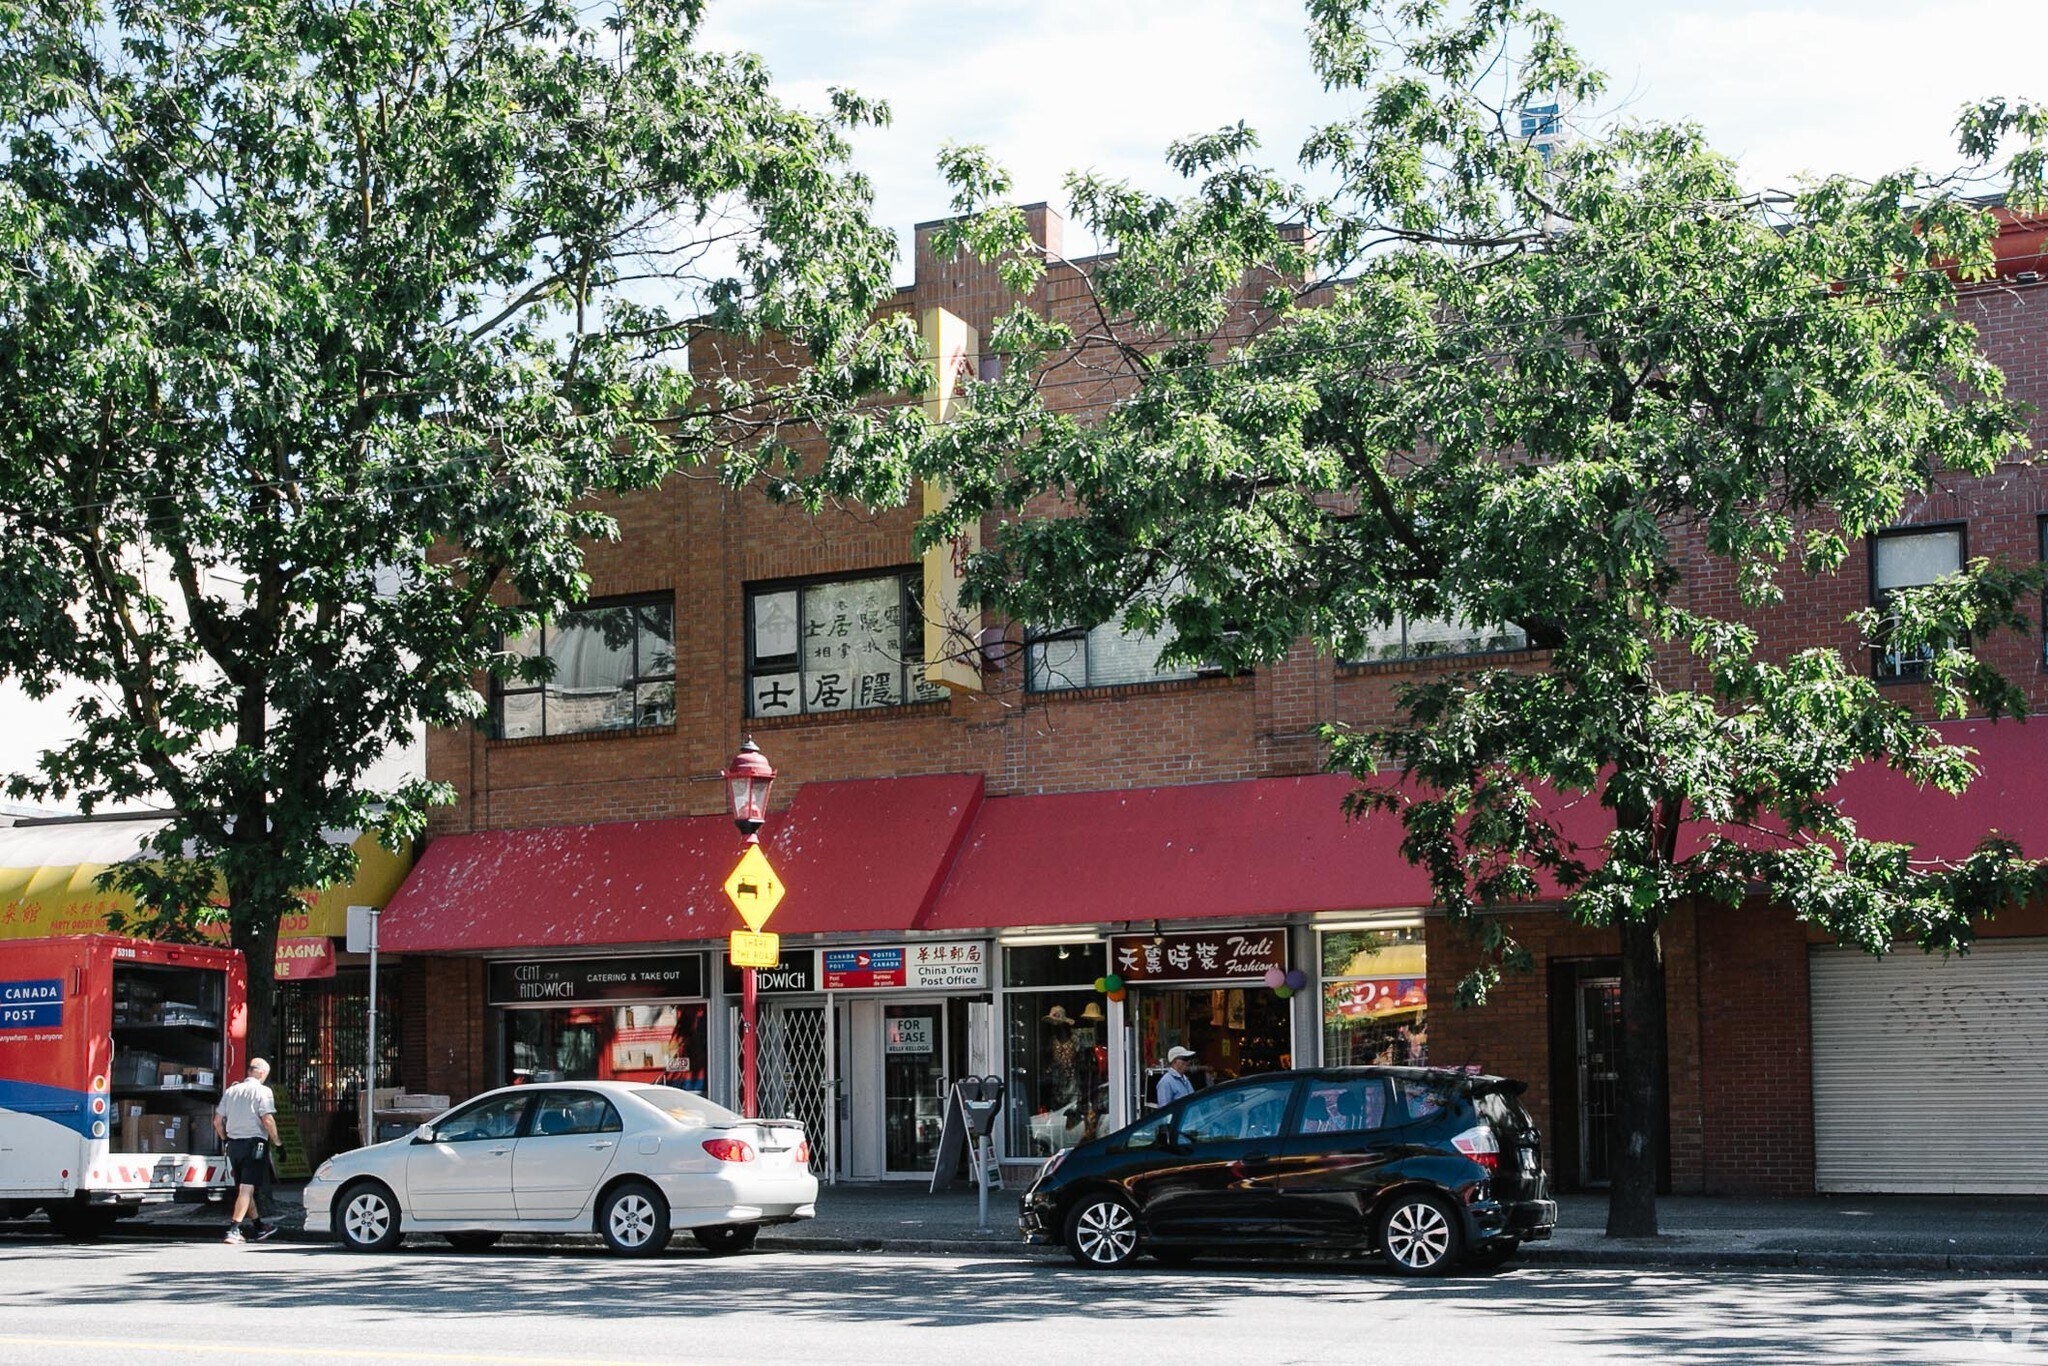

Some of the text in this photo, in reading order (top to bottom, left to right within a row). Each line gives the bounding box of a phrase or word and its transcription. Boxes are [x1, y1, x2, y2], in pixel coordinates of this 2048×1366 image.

[276, 943, 326, 958] SAGNA
[1227, 936, 1273, 957] Tinli
[917, 946, 981, 963] 華埠郵局
[514, 965, 540, 981] CENT
[918, 966, 979, 975] China Town
[587, 971, 680, 982] CATERING & TAKE OUT
[920, 976, 977, 986] Post Office
[5, 987, 57, 999] CANADA
[4, 1010, 36, 1021] POST
[898, 1020, 920, 1030] FOR
[41, 1033, 63, 1042] anyone
[893, 1032, 925, 1042] LEASE
